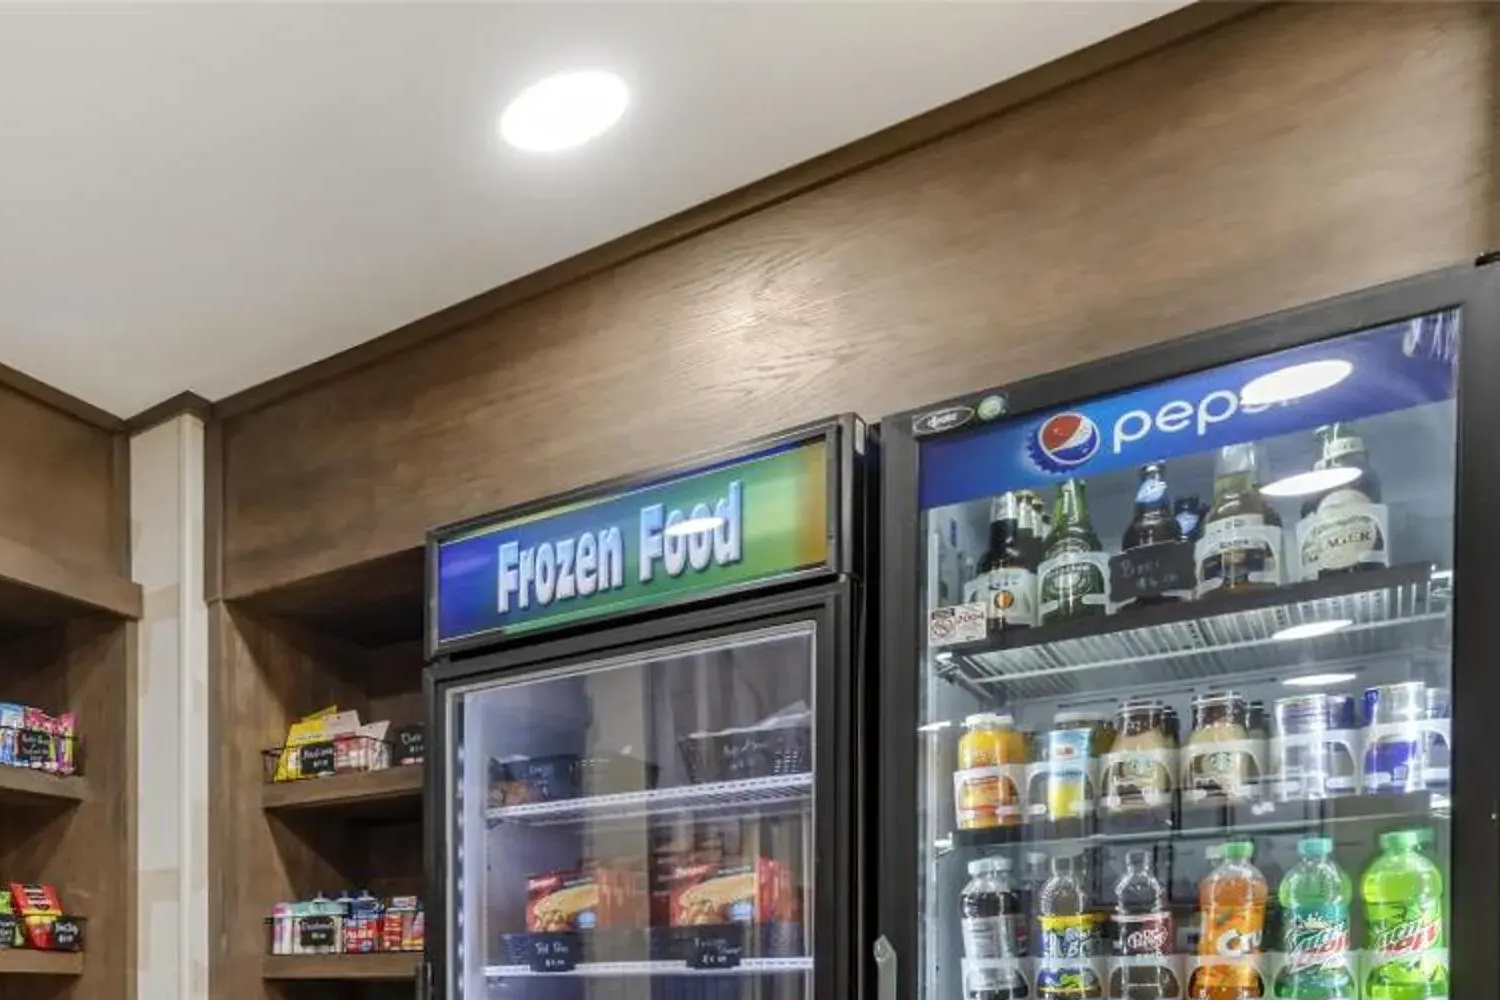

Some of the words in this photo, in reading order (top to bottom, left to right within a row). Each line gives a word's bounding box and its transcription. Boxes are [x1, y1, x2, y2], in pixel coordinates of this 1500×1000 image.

[1113, 382, 1290, 454] pep
[497, 524, 625, 614] Frozen
[638, 480, 743, 583] Food
[1217, 928, 1263, 957] Cru
